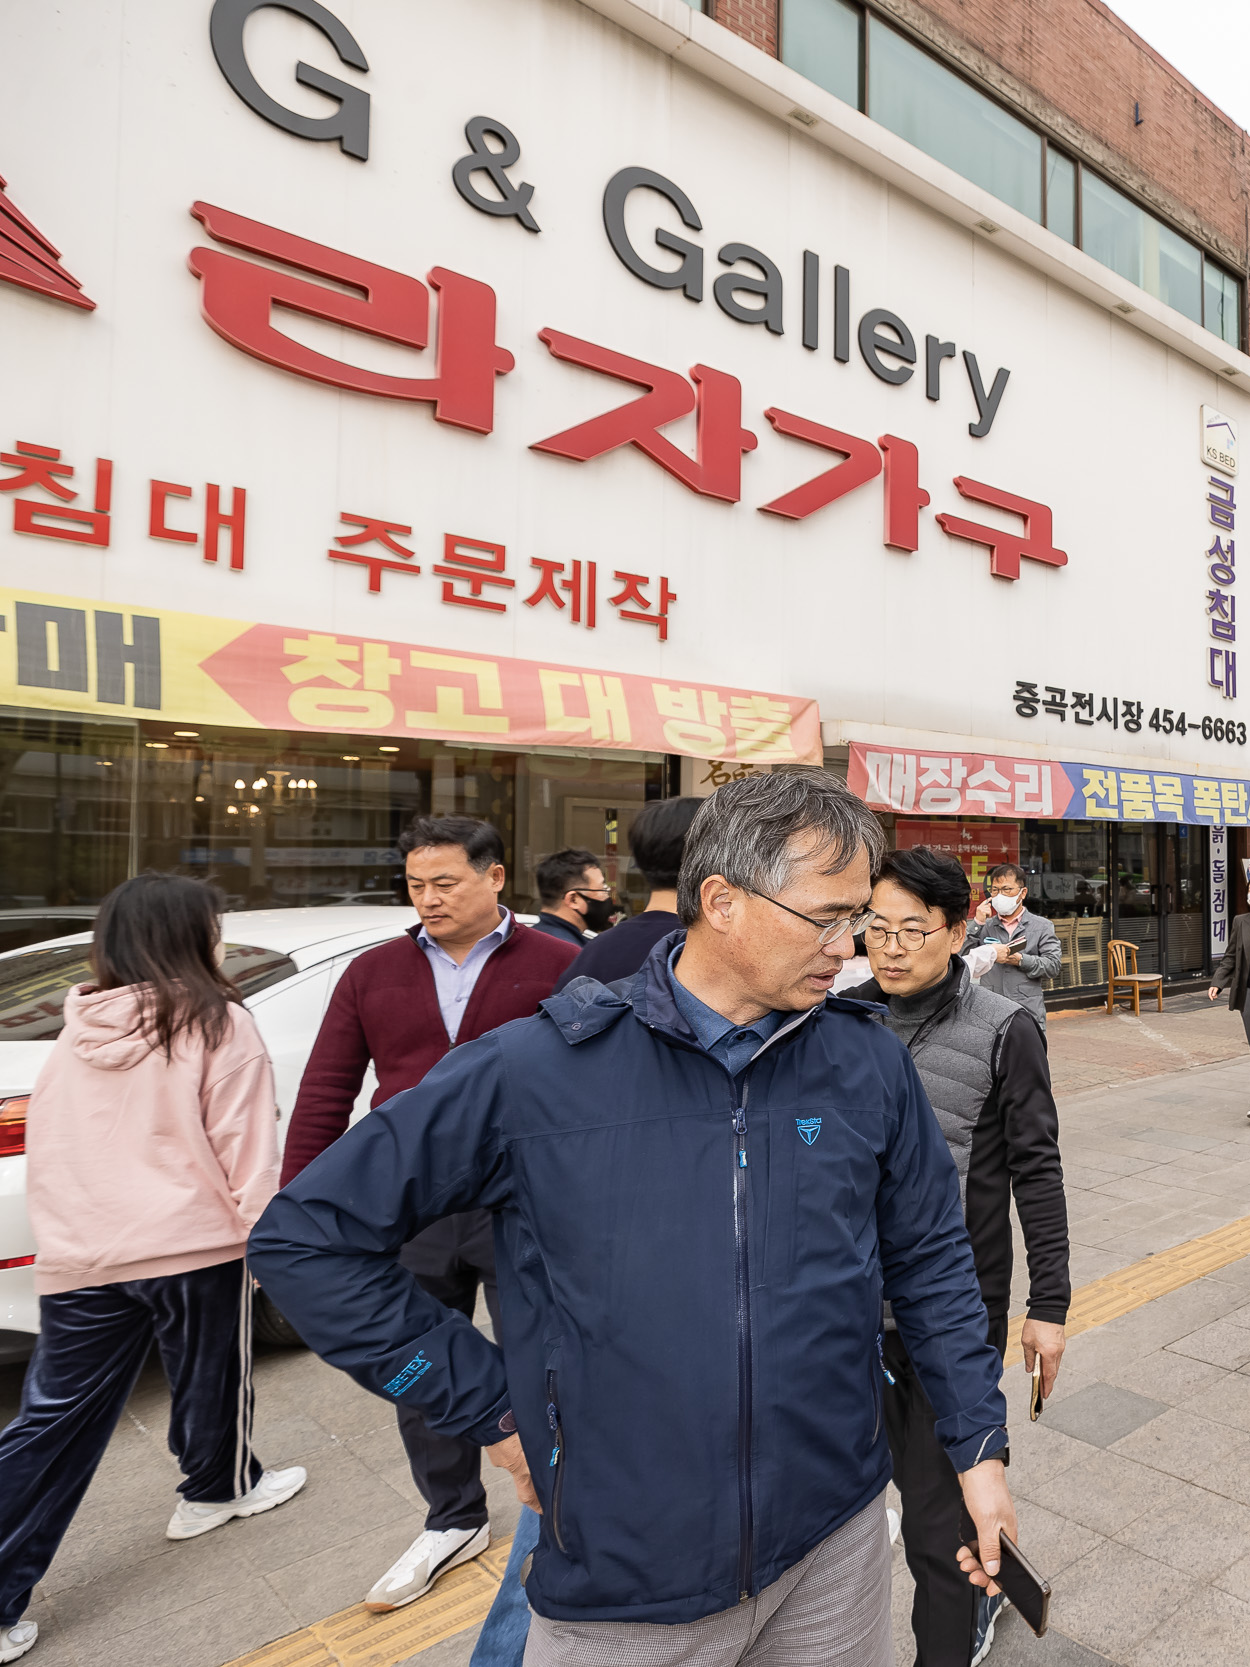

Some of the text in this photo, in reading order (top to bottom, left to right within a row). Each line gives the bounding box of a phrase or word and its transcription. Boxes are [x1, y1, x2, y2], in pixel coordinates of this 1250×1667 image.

[210, 0, 1011, 439] G & Gallery
[188, 201, 1069, 581] 라자가구
[1206, 445, 1236, 468] KS BED
[0, 440, 678, 641] 침대 주문제작
[1206, 475, 1237, 699] 금성침대
[0, 601, 162, 711] 매
[280, 633, 798, 760] 창고 대 방출
[1013, 680, 1247, 745] 중곡전시장 454-6663
[866, 750, 1054, 816] 매장수리
[1082, 767, 1185, 821] 전품목
